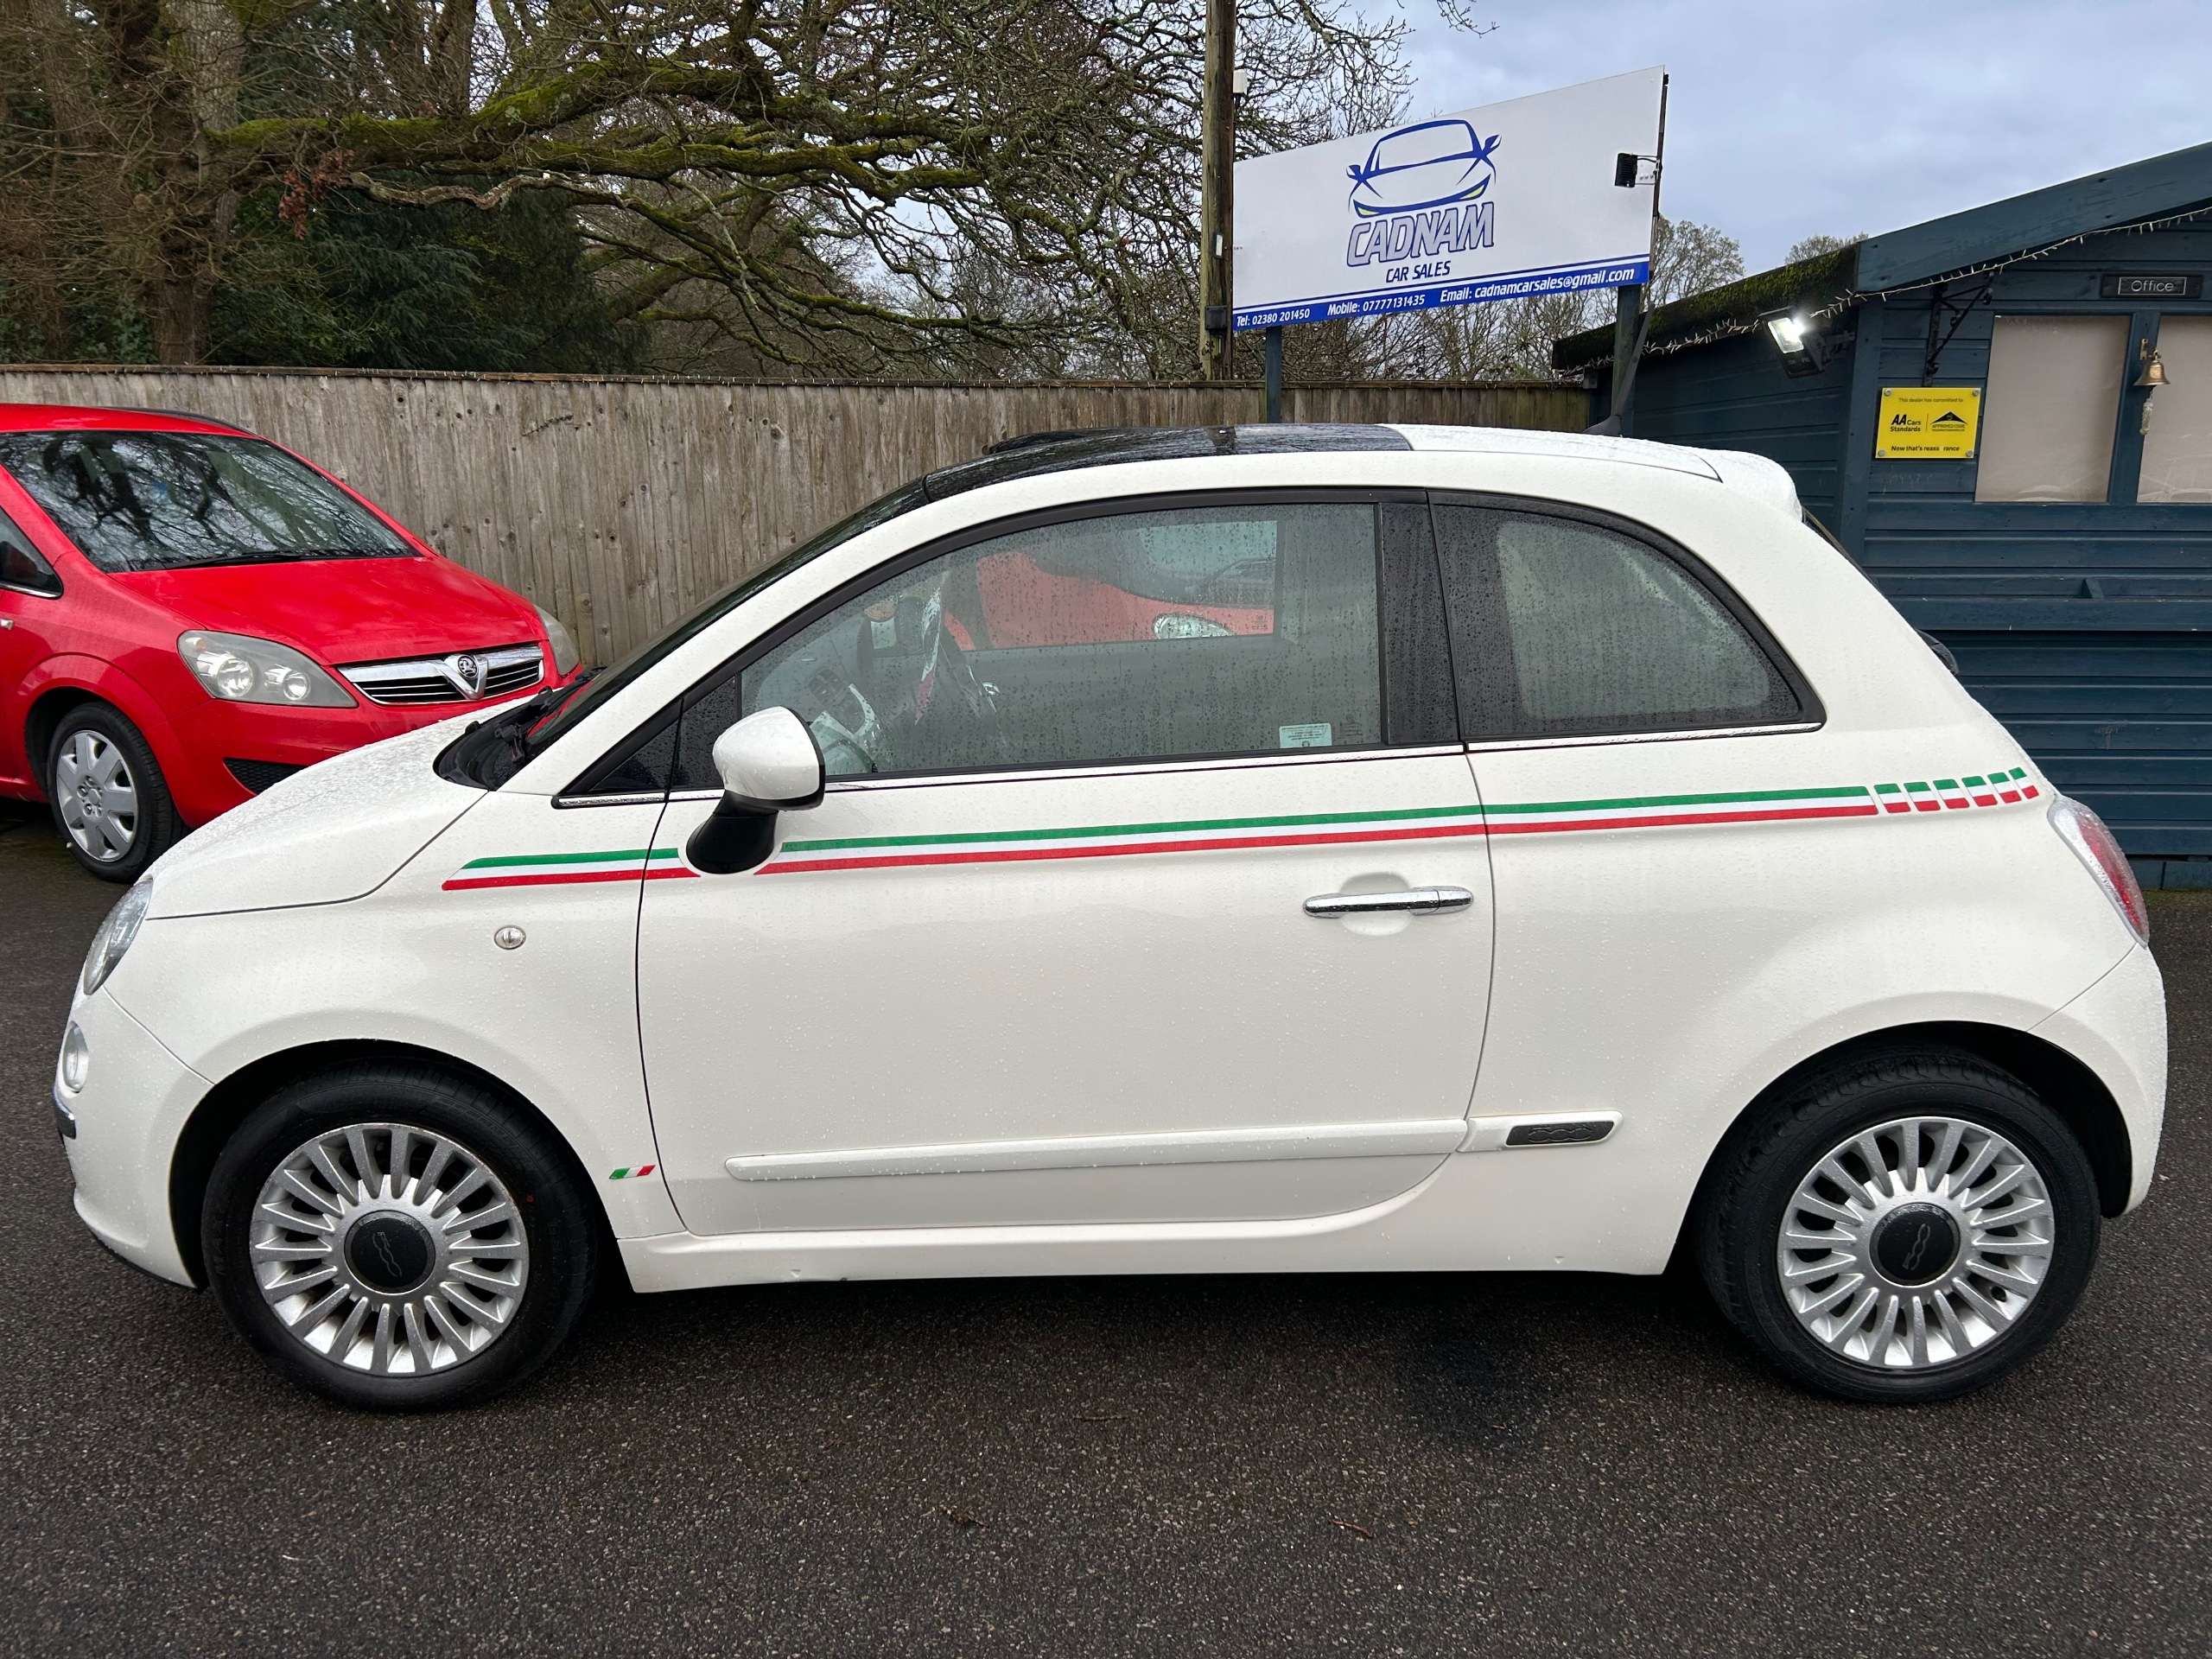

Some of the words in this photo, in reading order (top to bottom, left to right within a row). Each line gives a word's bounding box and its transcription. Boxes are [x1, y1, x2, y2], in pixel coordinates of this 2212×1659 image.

[1347, 201, 1494, 267] CADNAM
[1386, 266, 1409, 283] CAR
[1412, 260, 1452, 280] SALES
[1236, 315, 1250, 327] Tel:
[1252, 313, 1278, 325] 02380
[1280, 308, 1311, 321] 201450
[1327, 302, 1361, 316] Mobile:
[1363, 295, 1426, 312] 07777131435
[1440, 287, 1472, 302] Email:
[1475, 268, 1635, 299] cadnamcarsales@gmail.com
[2131, 280, 2174, 292] Office
[1891, 414, 1907, 425] AA
